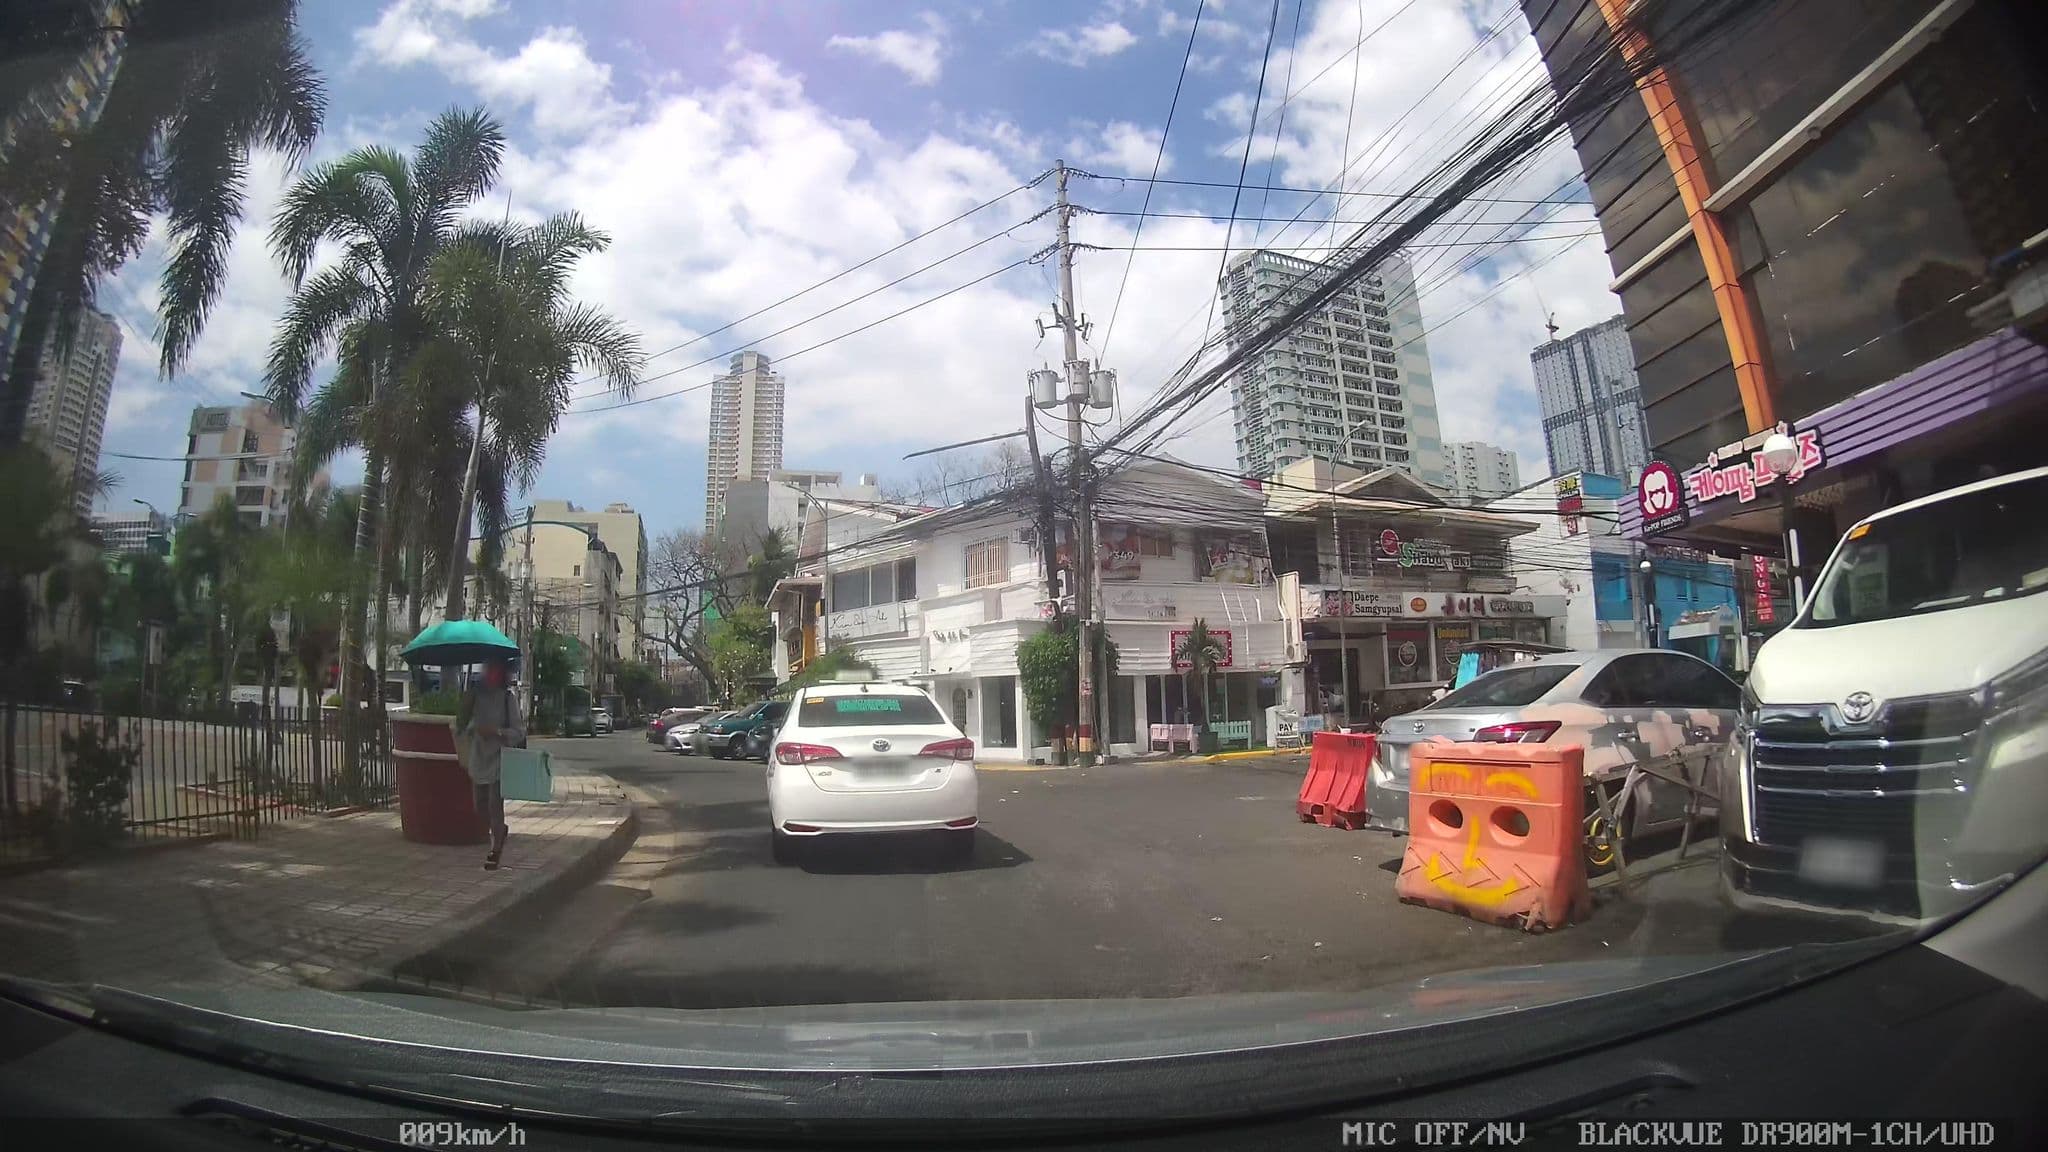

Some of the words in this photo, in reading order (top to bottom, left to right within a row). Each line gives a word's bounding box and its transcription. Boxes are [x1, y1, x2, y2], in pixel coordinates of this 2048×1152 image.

[1688, 462, 1755, 503] 케이팝
[1354, 592, 1380, 604] Daepe
[1354, 603, 1403, 616] Samgyupsal
[1279, 723, 1294, 732] PAY
